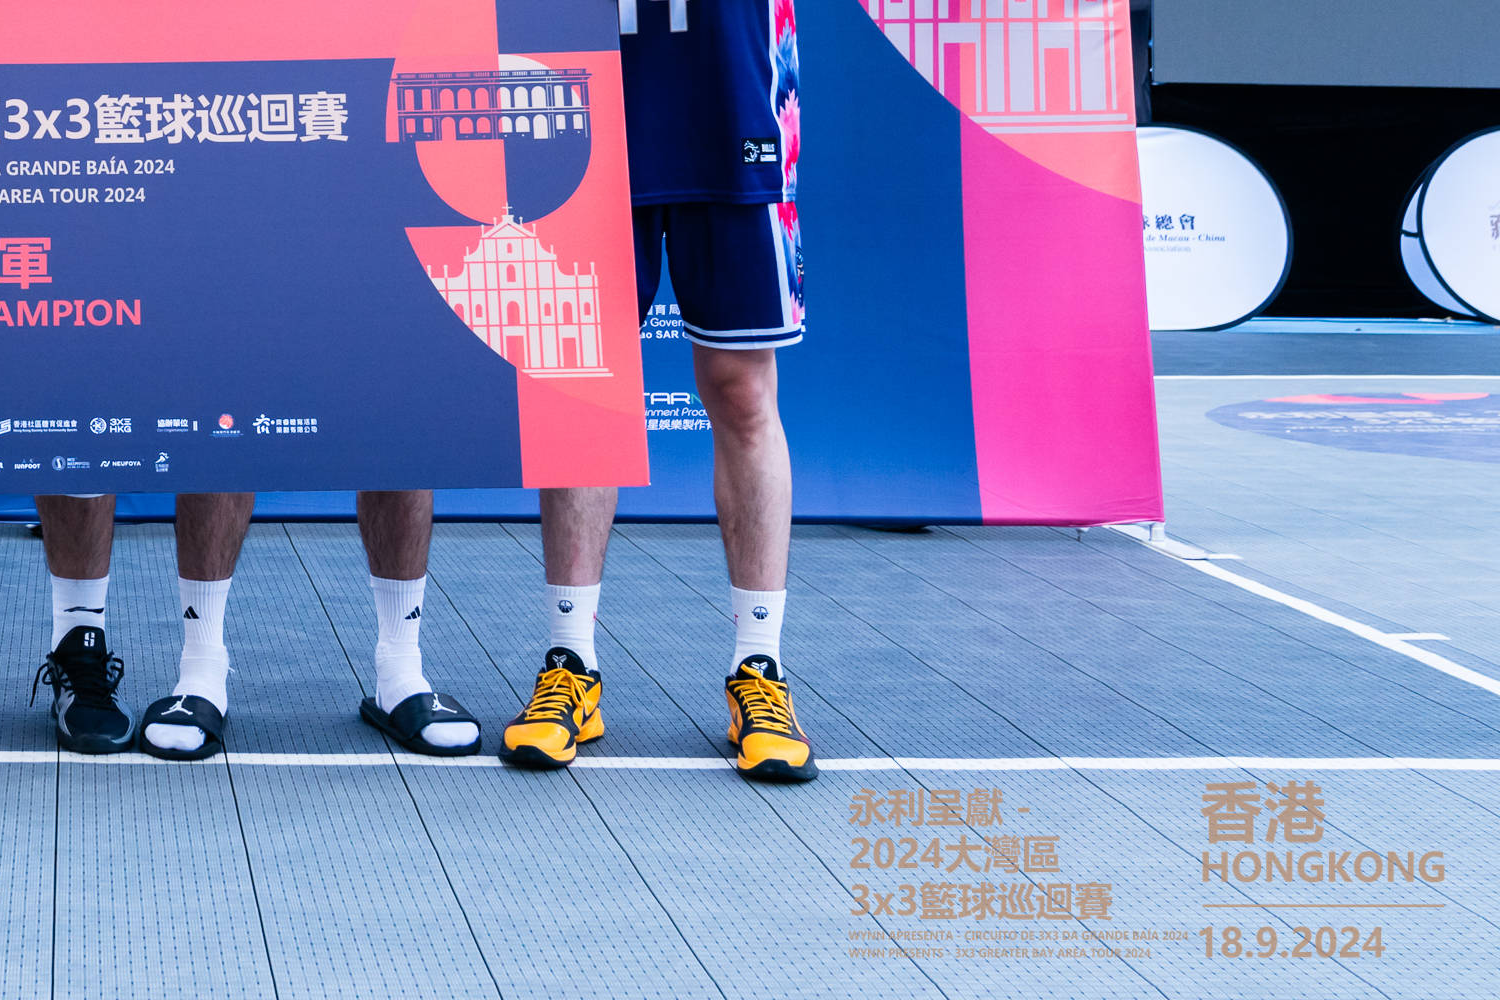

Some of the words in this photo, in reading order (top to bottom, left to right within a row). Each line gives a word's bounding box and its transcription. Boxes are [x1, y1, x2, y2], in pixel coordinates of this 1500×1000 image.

[6, 160, 80, 176] GRANDE
[87, 158, 128, 175] BAÍA
[134, 160, 175, 175] 2024
[50, 188, 99, 203] TOUR
[105, 188, 145, 203] 2024
[656, 330, 679, 339] SAR
